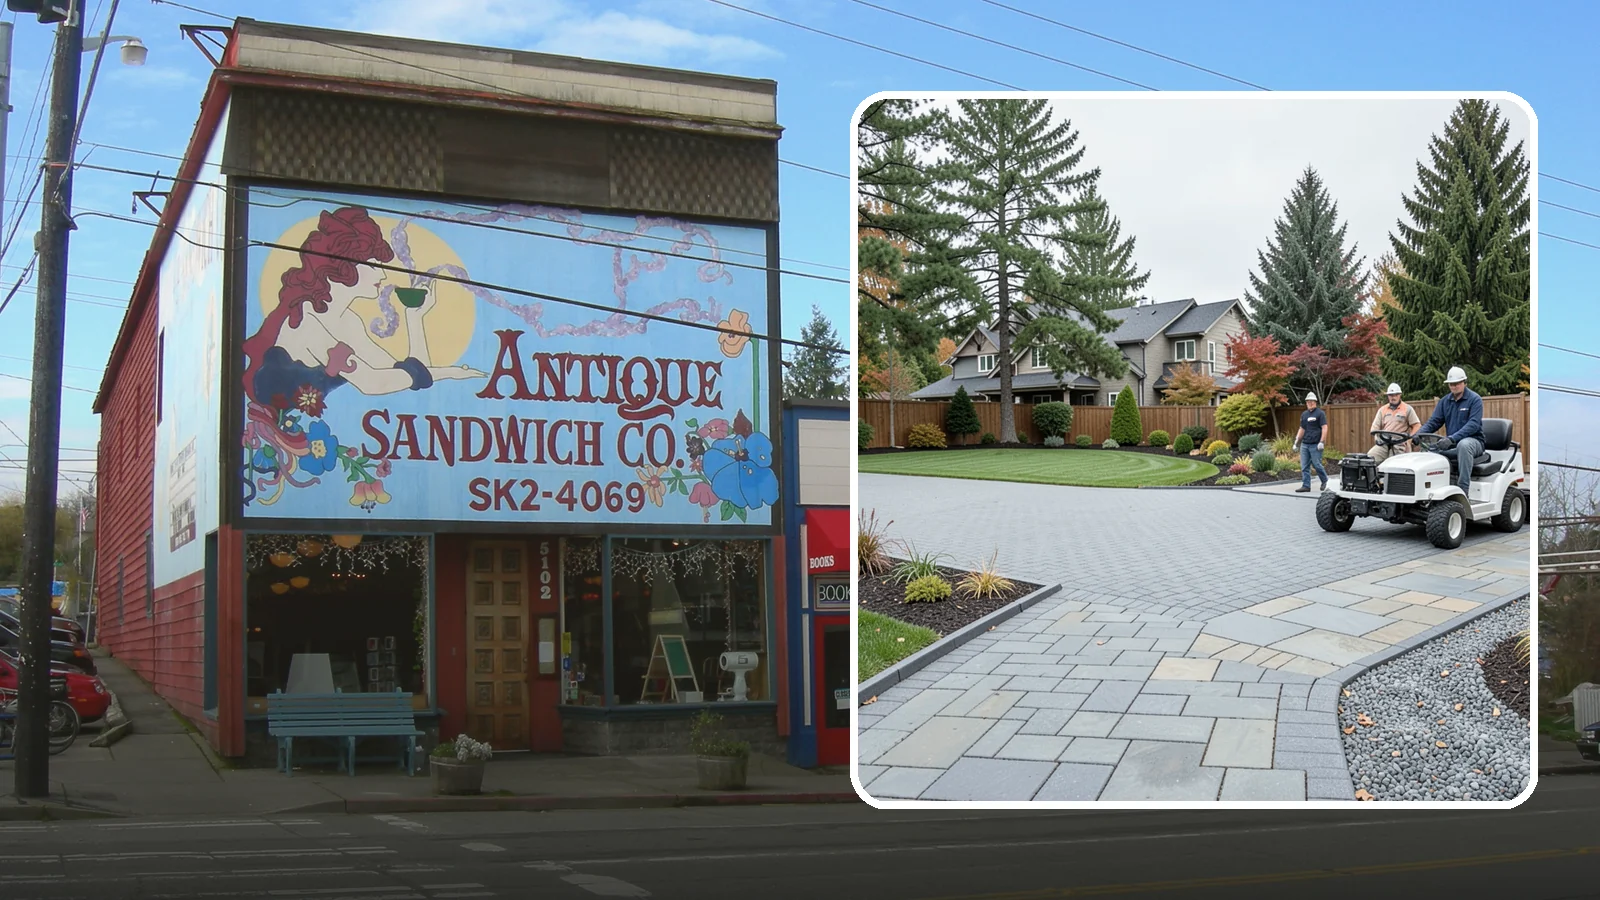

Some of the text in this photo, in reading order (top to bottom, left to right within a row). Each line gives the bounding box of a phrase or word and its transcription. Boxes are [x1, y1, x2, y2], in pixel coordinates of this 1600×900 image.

[476, 329, 723, 420] ANTIQUE
[361, 409, 685, 469] SANDWICH CO.
[468, 477, 645, 513] SK2-4069
[540, 542, 551, 599] 5102
[809, 555, 834, 568] BOOKS
